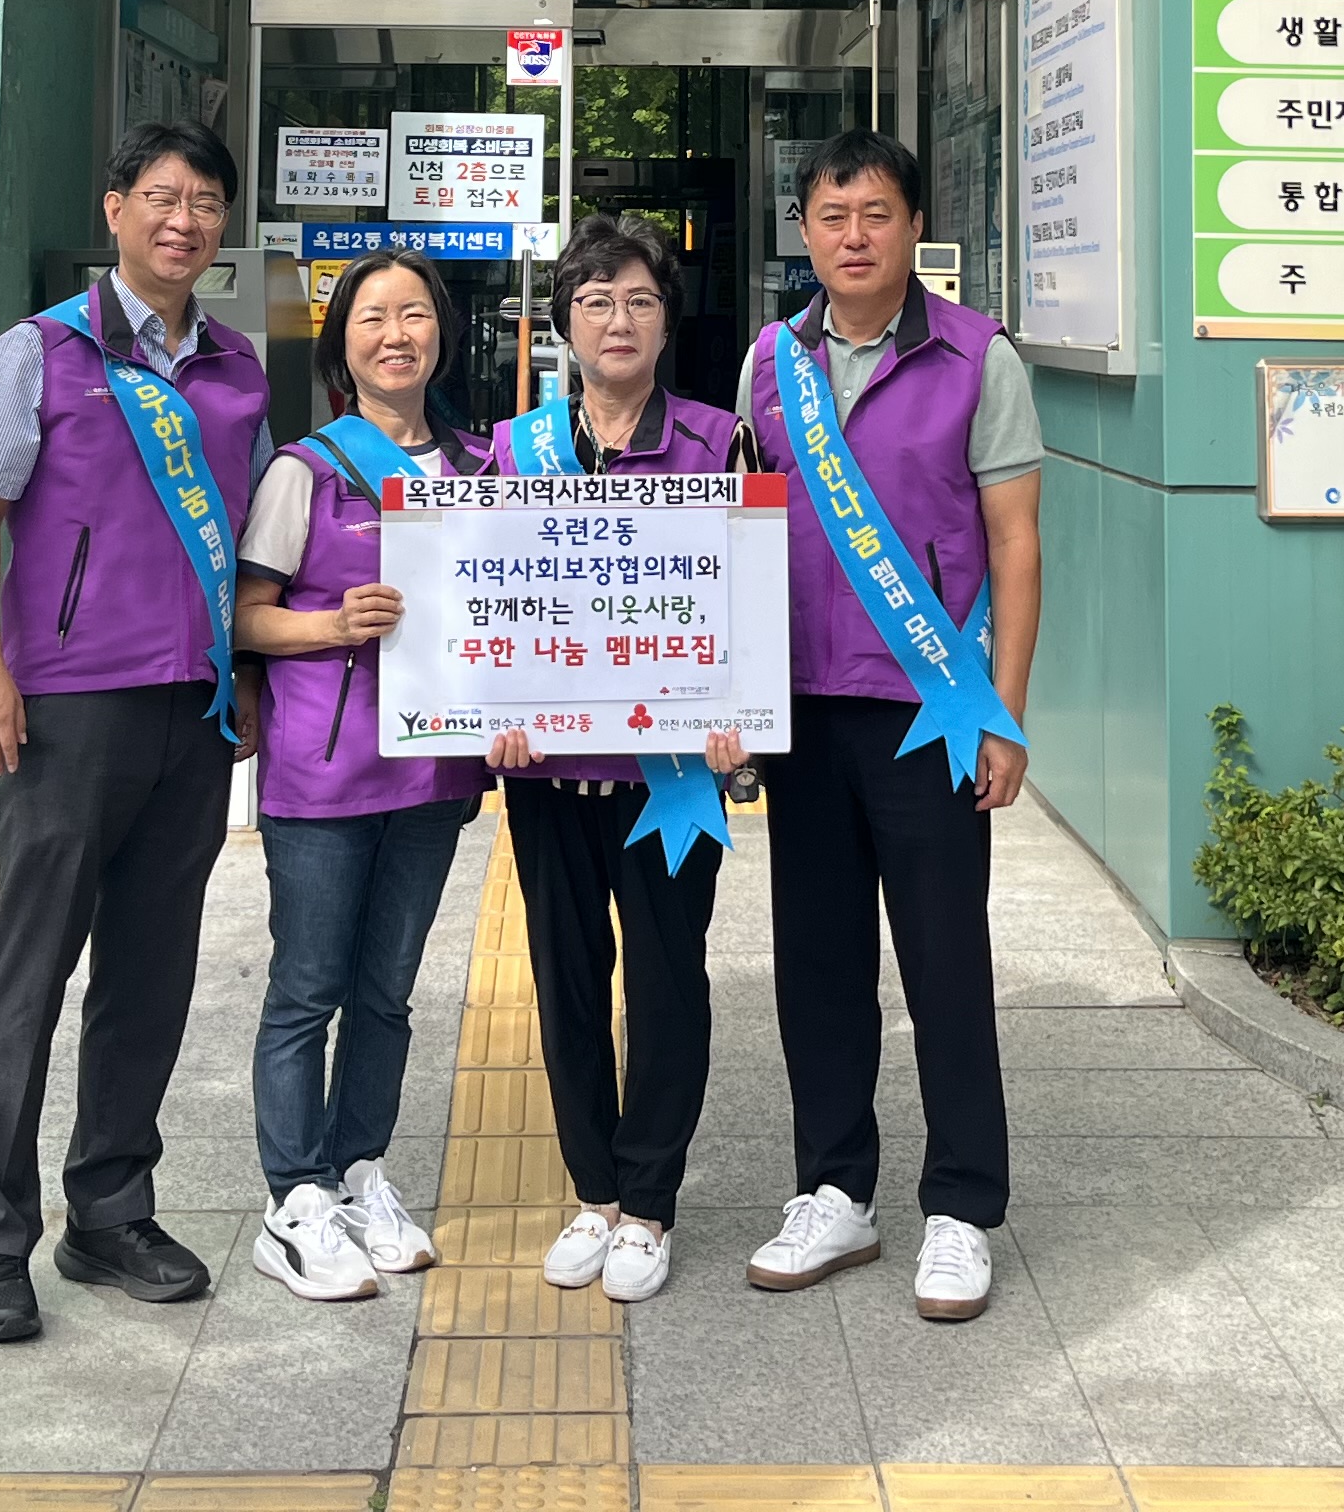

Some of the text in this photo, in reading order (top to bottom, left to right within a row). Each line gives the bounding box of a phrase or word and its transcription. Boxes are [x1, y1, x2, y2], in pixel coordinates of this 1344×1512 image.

[408, 138, 530, 155] 민생회복 소비쿠폰
[307, 171, 317, 182] 화
[326, 172, 336, 183] 수
[365, 172, 374, 183] 금
[408, 161, 526, 182] 신청 2층으로
[413, 187, 454, 207] 토,일
[313, 231, 503, 251] 옥련2동 행정복지센터
[787, 268, 817, 289] 옥련2
[530, 413, 564, 475] 이웃사
[405, 476, 738, 507] 옥련2동 지역사회보장협의체
[537, 516, 638, 547] 옥련2동
[455, 555, 722, 586] 지역사회보장협의체와
[466, 594, 706, 626] 함께하는 이웃사랑,
[534, 636, 589, 667] 나눔
[398, 710, 593, 738] Yeonsu 연수구 옥련2동
[659, 719, 680, 731] 인천
